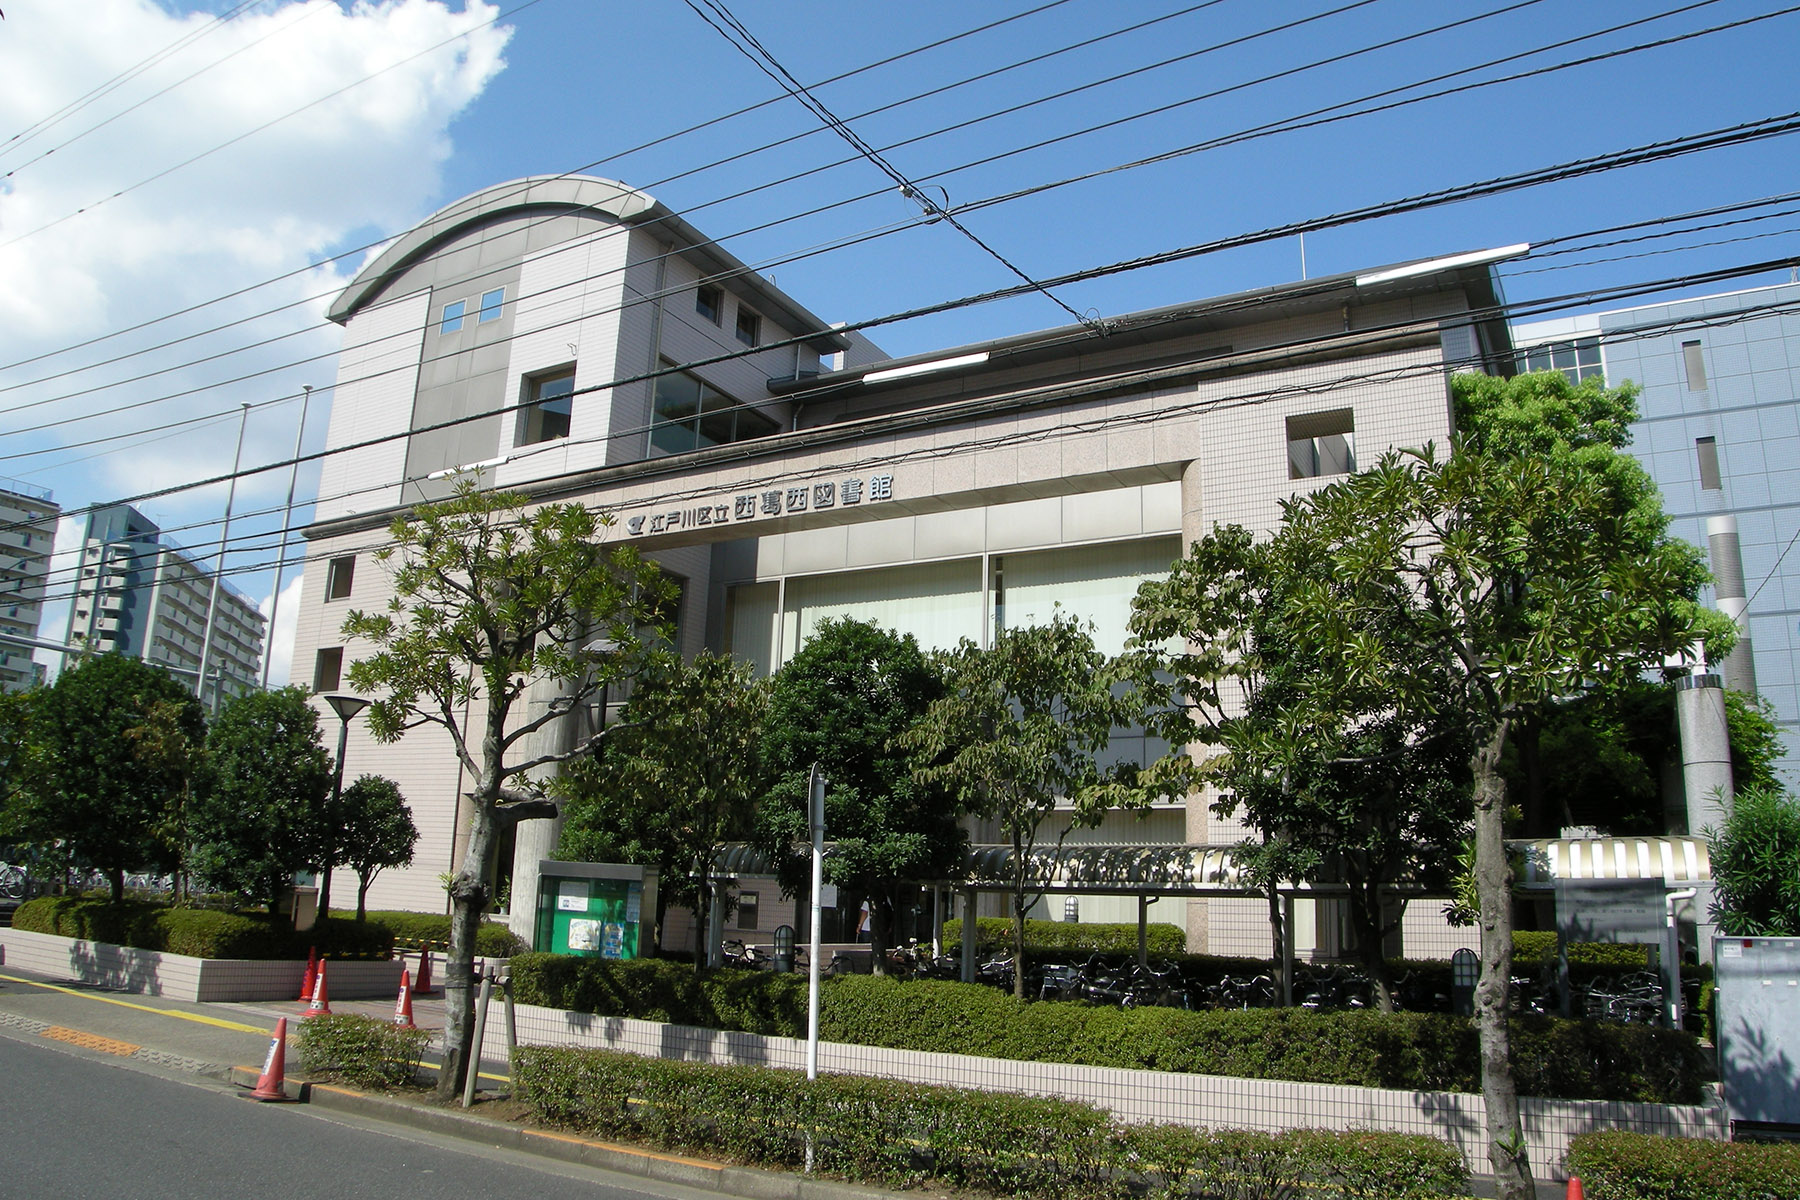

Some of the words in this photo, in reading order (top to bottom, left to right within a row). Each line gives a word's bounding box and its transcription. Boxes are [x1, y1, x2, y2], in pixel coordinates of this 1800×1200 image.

[650, 474, 893, 532] 江戸川区立西葛西図書館
